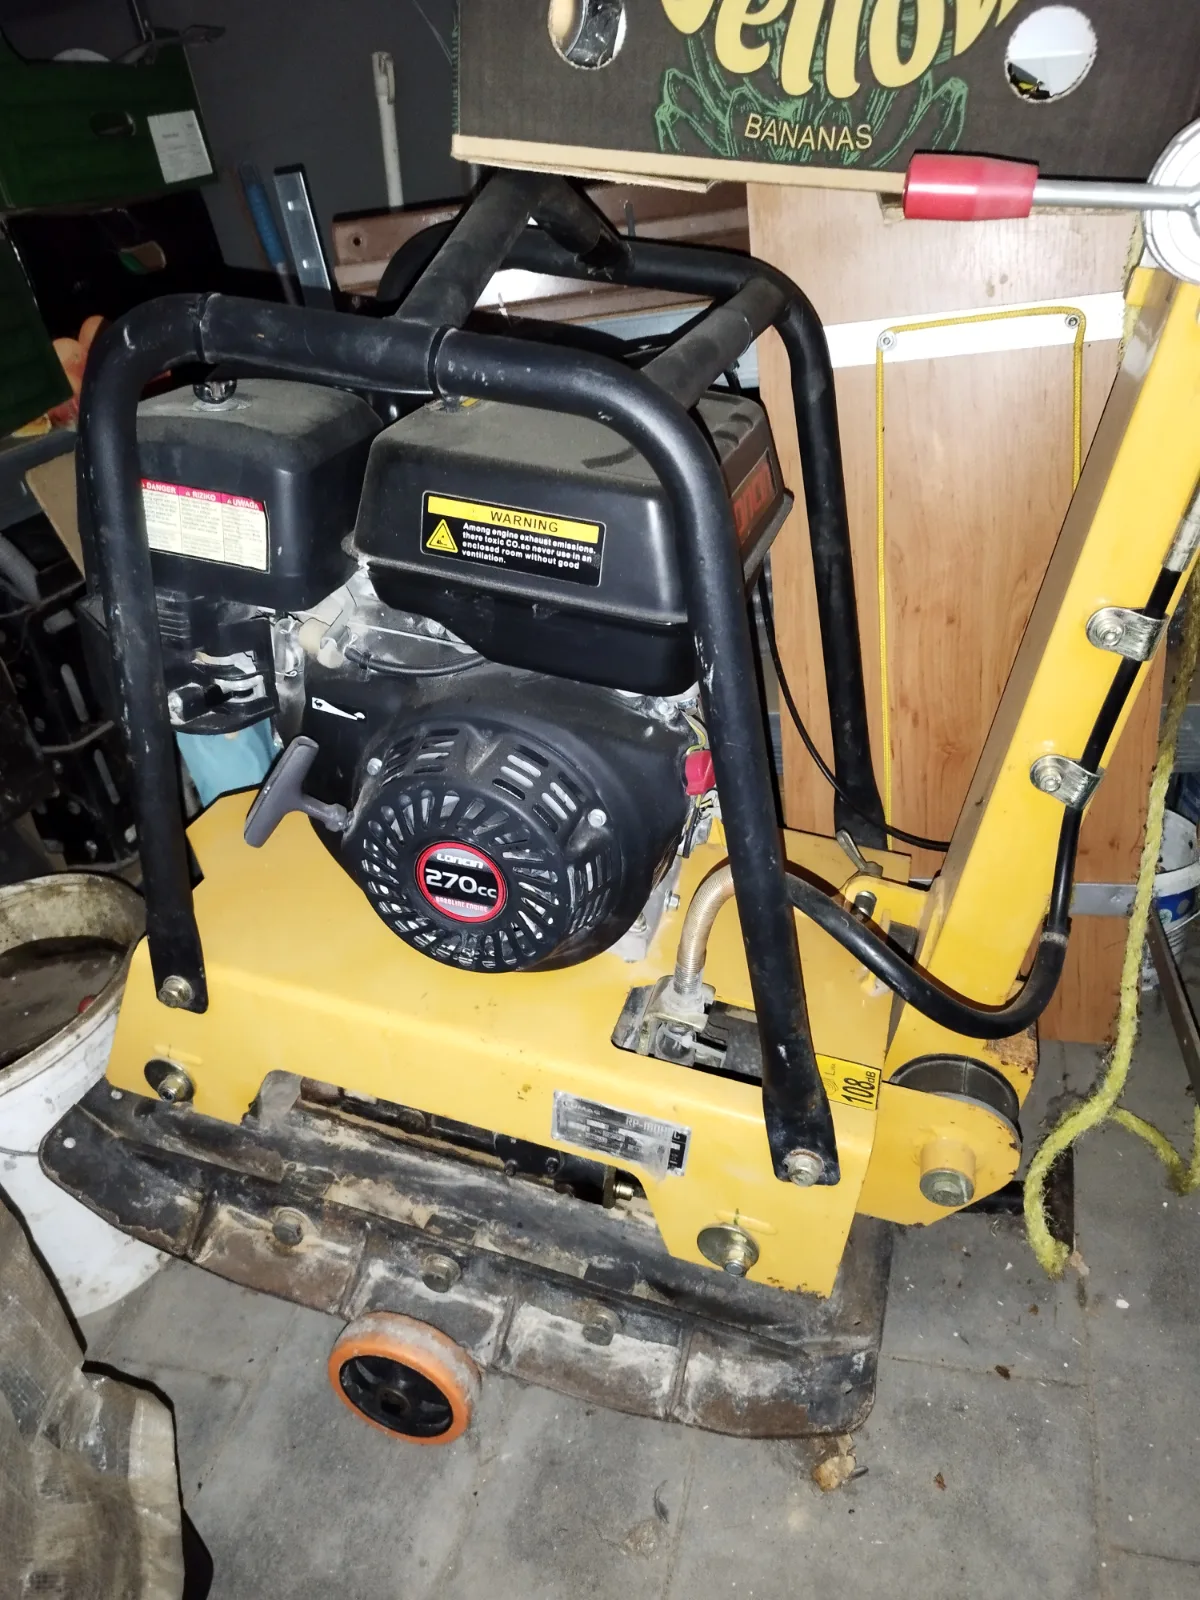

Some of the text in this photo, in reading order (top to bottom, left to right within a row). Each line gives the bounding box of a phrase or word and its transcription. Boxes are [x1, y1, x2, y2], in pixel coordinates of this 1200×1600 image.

[744, 112, 873, 151] BANANAS
[146, 482, 177, 495] DANGER
[192, 490, 217, 502] RIZIKO
[233, 498, 260, 510] UWAGA
[490, 510, 558, 533] WARNING
[462, 522, 491, 536] Among
[492, 529, 519, 540] engine
[520, 534, 552, 546] exhaust
[461, 549, 507, 564] ventilation.
[462, 531, 483, 542] there
[484, 536, 505, 546] toxic
[532, 545, 555, 556] never
[556, 550, 571, 559] use
[572, 552, 581, 561] in
[581, 555, 592, 563] an
[462, 541, 580, 570] enclosed room without good
[425, 867, 497, 899] 270cc
